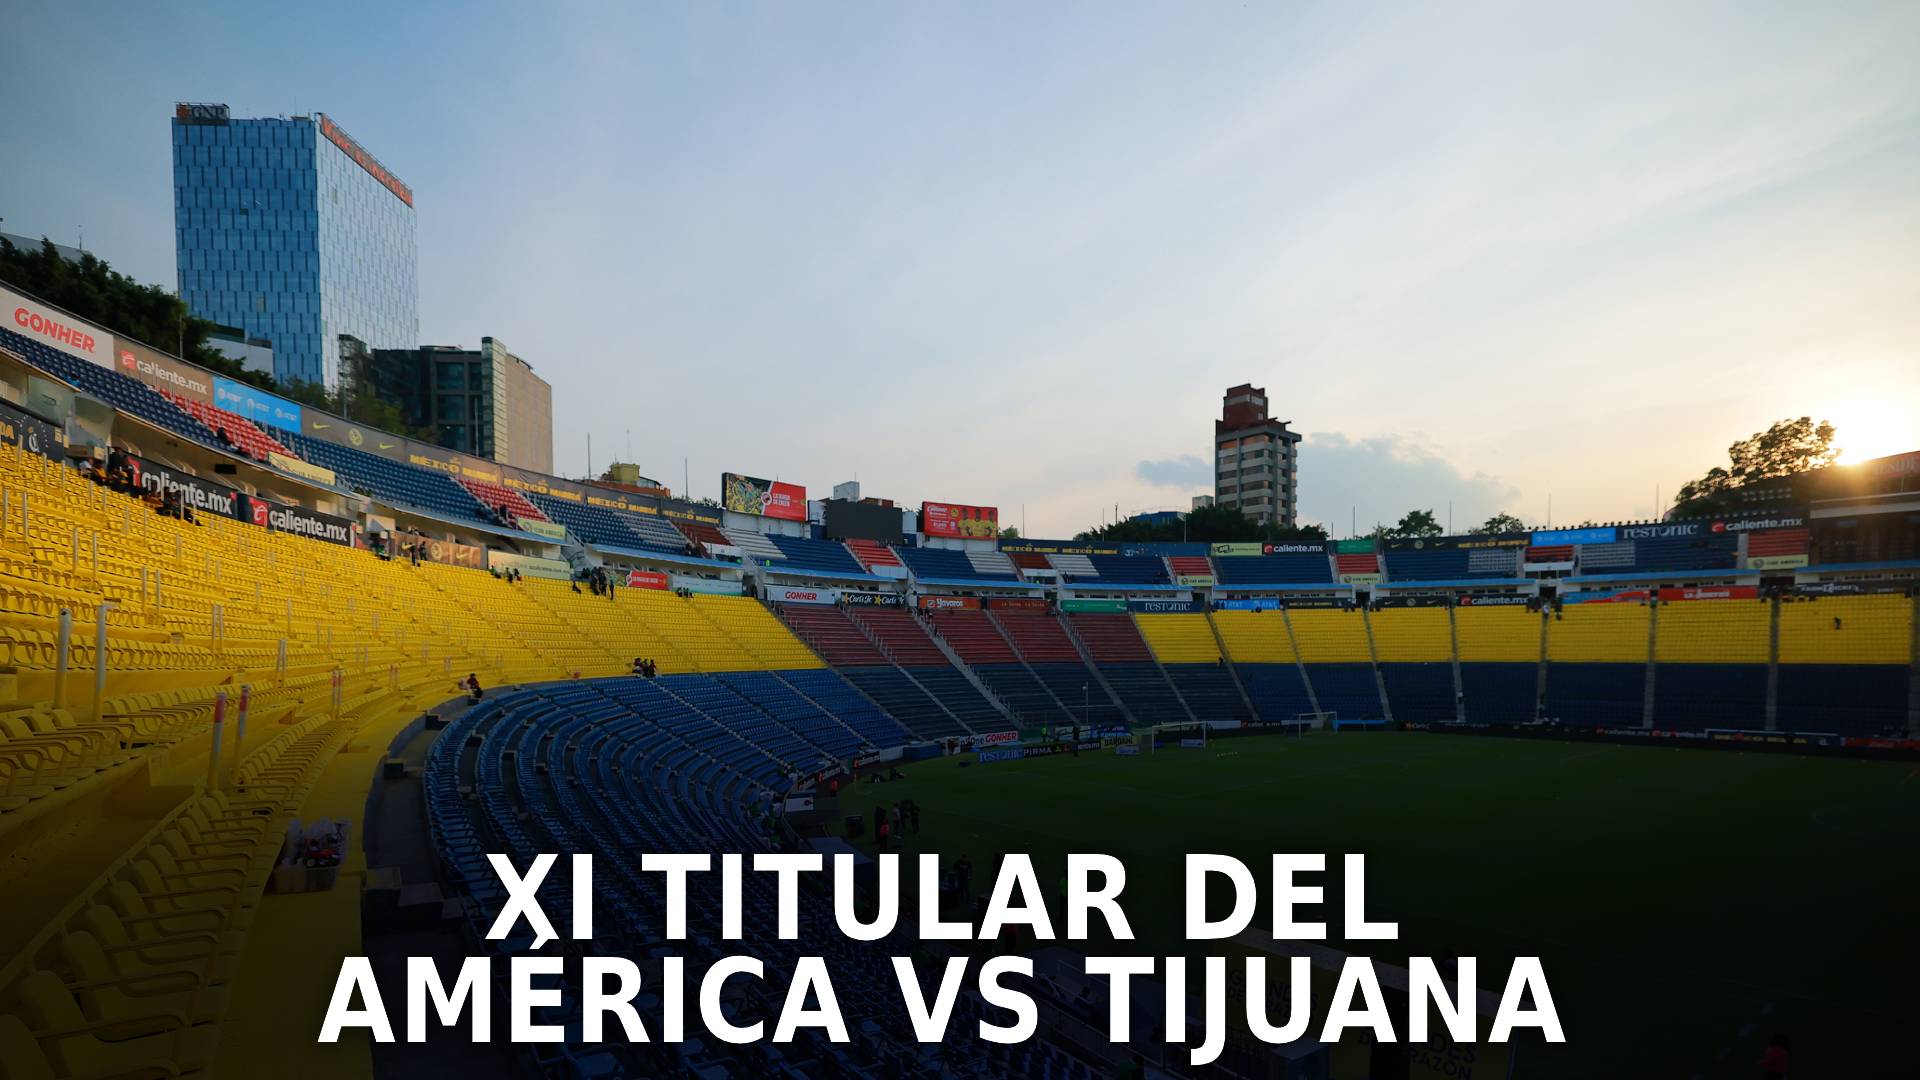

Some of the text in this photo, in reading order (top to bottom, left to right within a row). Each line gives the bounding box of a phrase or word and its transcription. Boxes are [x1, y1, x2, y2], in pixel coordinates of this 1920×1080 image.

[15, 307, 95, 353] GONHER
[136, 361, 208, 395] caliente.mx
[269, 509, 348, 542] caliente.mx
[1726, 518, 1803, 531] caliente.mx
[1273, 544, 1323, 552] caliente.mx
[785, 591, 817, 601] GONHER
